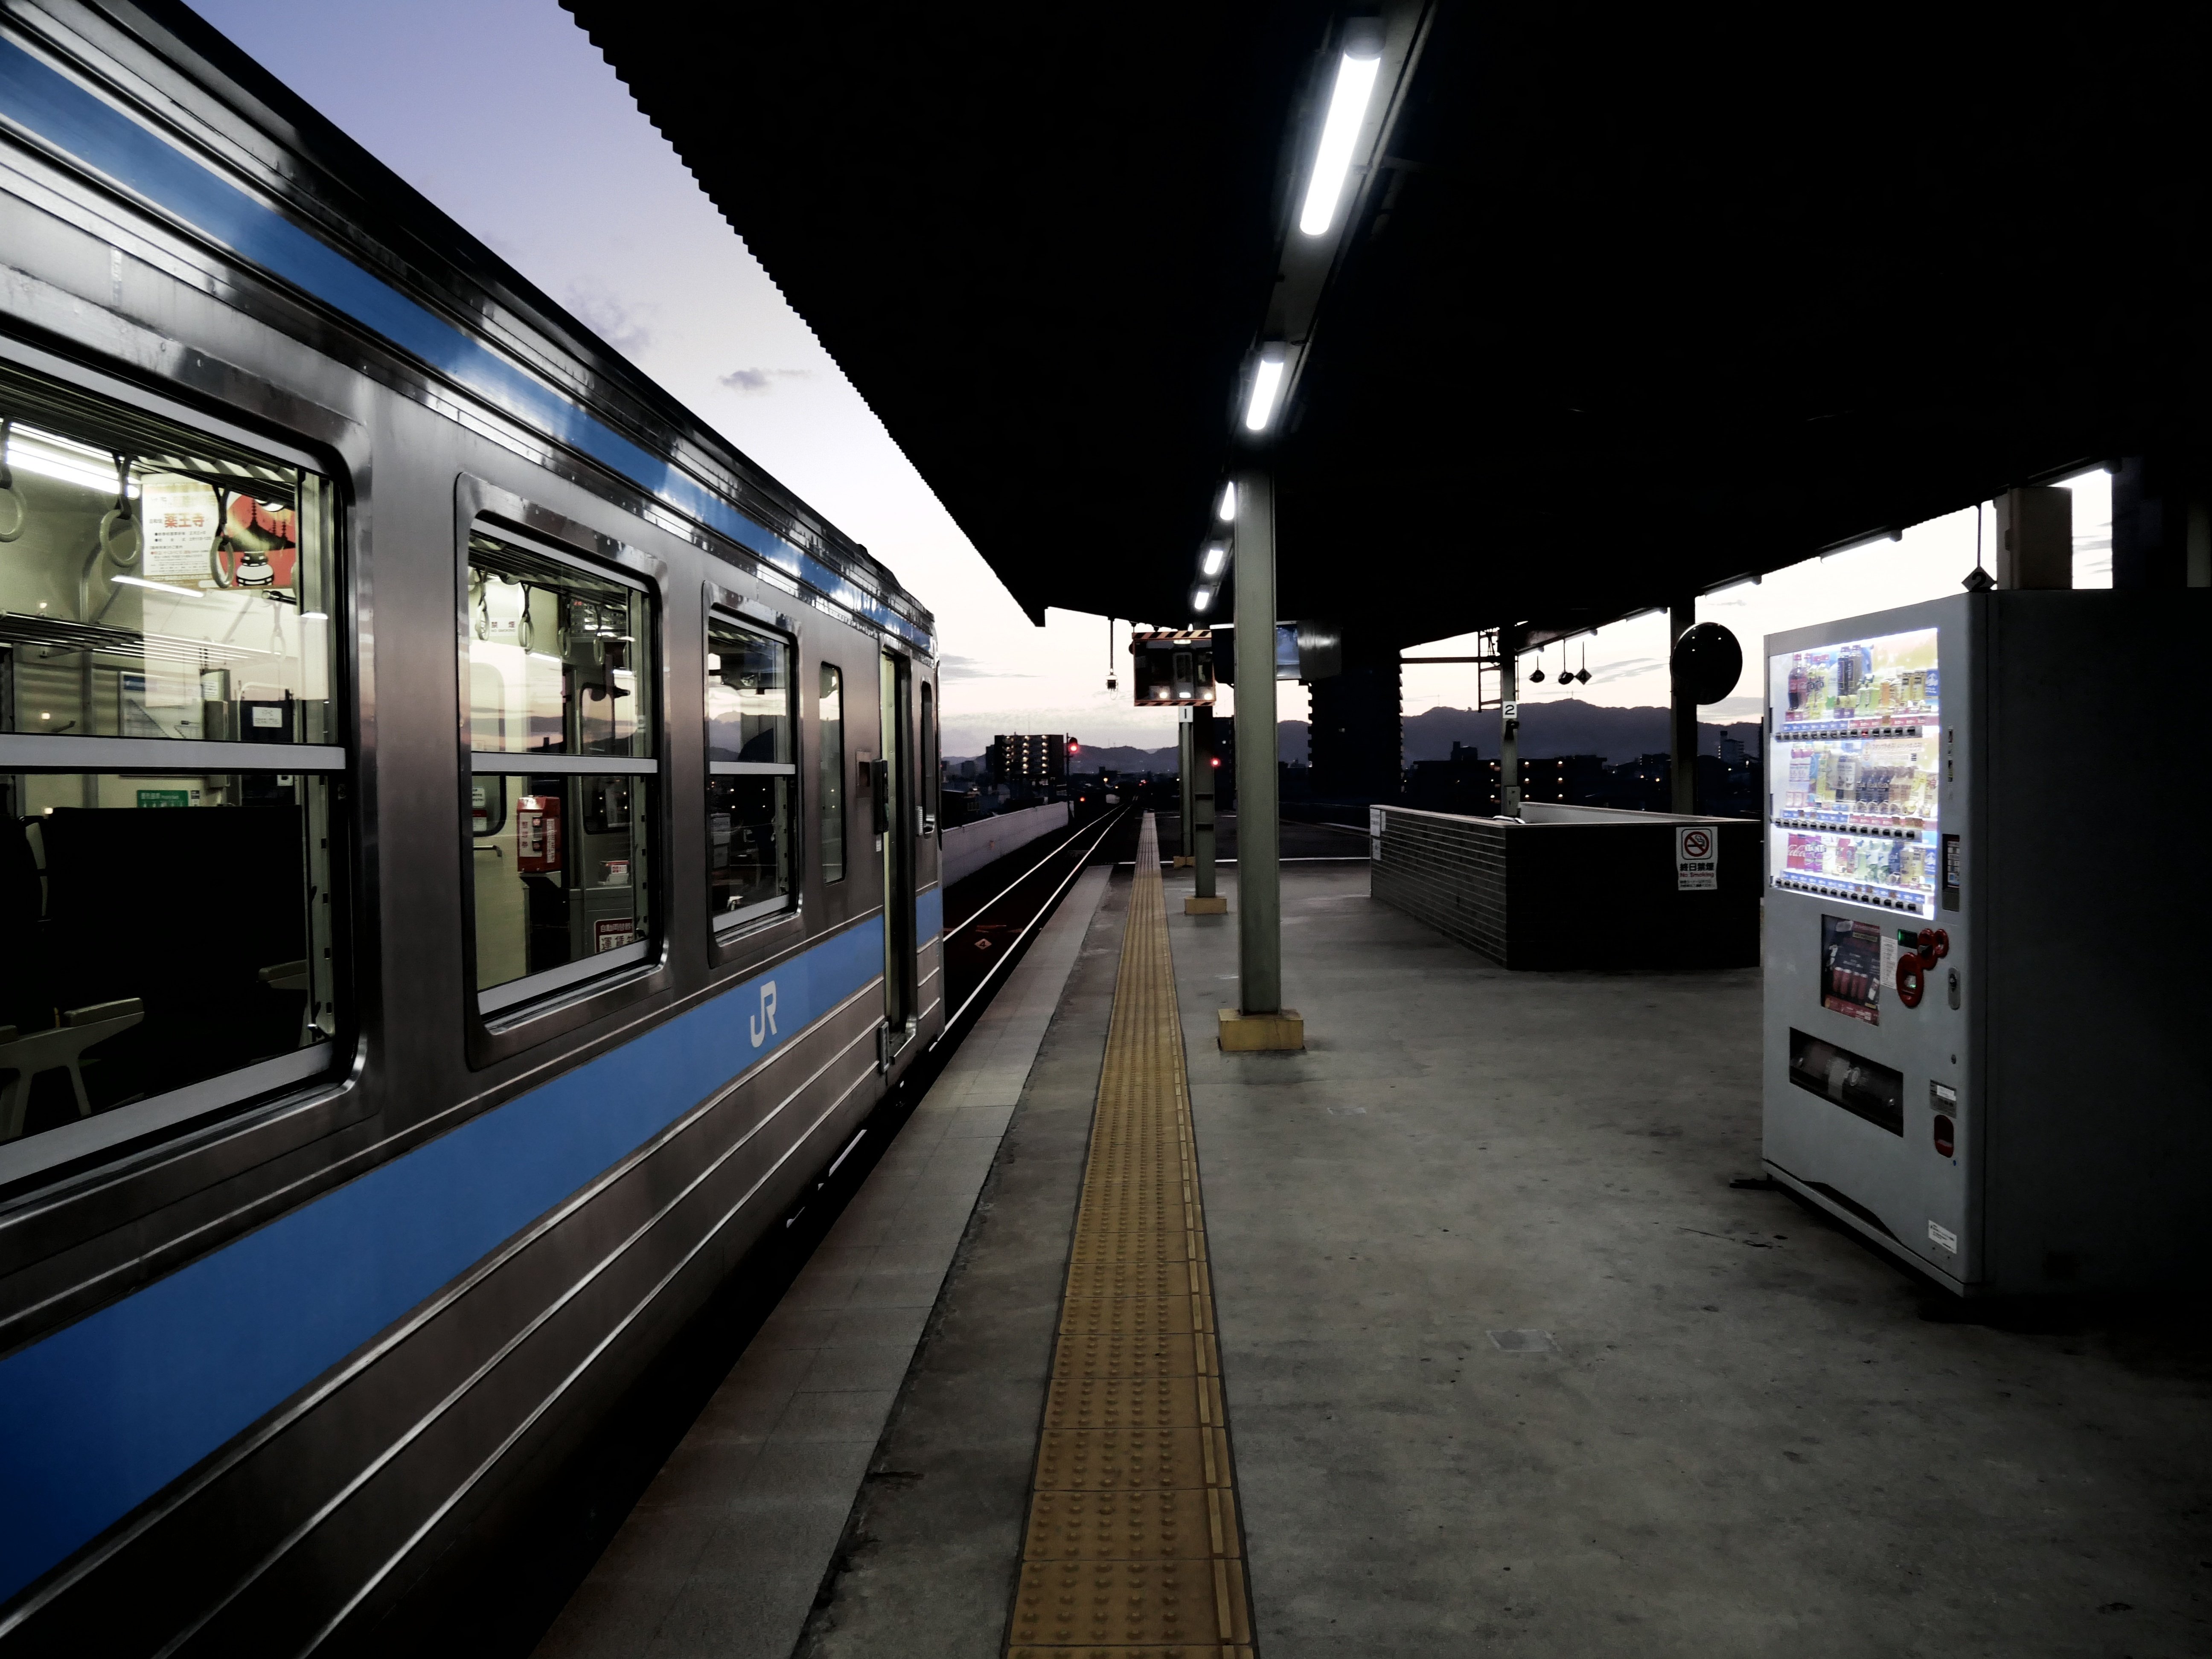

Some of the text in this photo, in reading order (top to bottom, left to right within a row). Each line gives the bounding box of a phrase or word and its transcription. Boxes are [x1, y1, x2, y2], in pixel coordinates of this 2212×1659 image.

[164, 513, 205, 528] 薬王寺
[1972, 572, 1991, 592] 2
[1580, 671, 1587, 681] 4
[1505, 705, 1515, 715] 2
[1680, 863, 1714, 871] 終日禁煙
[751, 980, 777, 1048] JR
